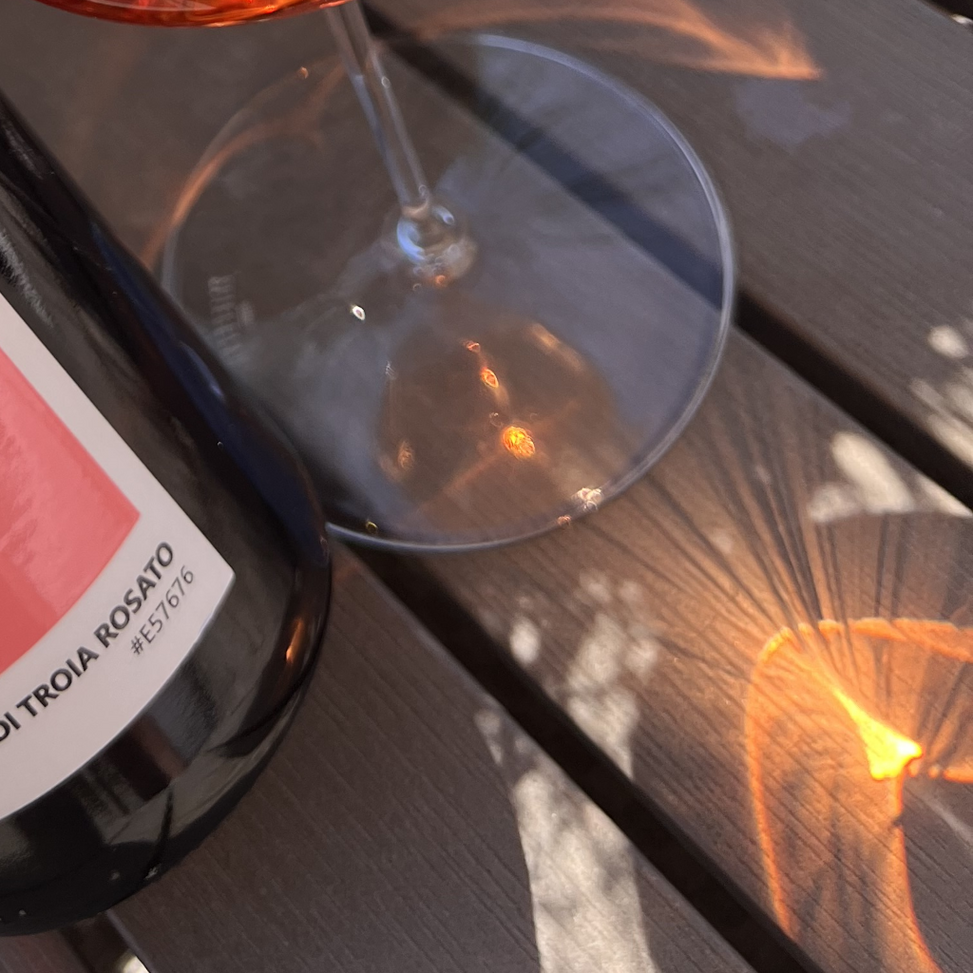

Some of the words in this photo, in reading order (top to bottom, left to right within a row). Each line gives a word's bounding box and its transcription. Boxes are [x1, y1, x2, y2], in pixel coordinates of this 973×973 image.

[16, 645, 99, 718] TROIA
[93, 541, 174, 648] ROSATO
[130, 565, 194, 655] #E57676
